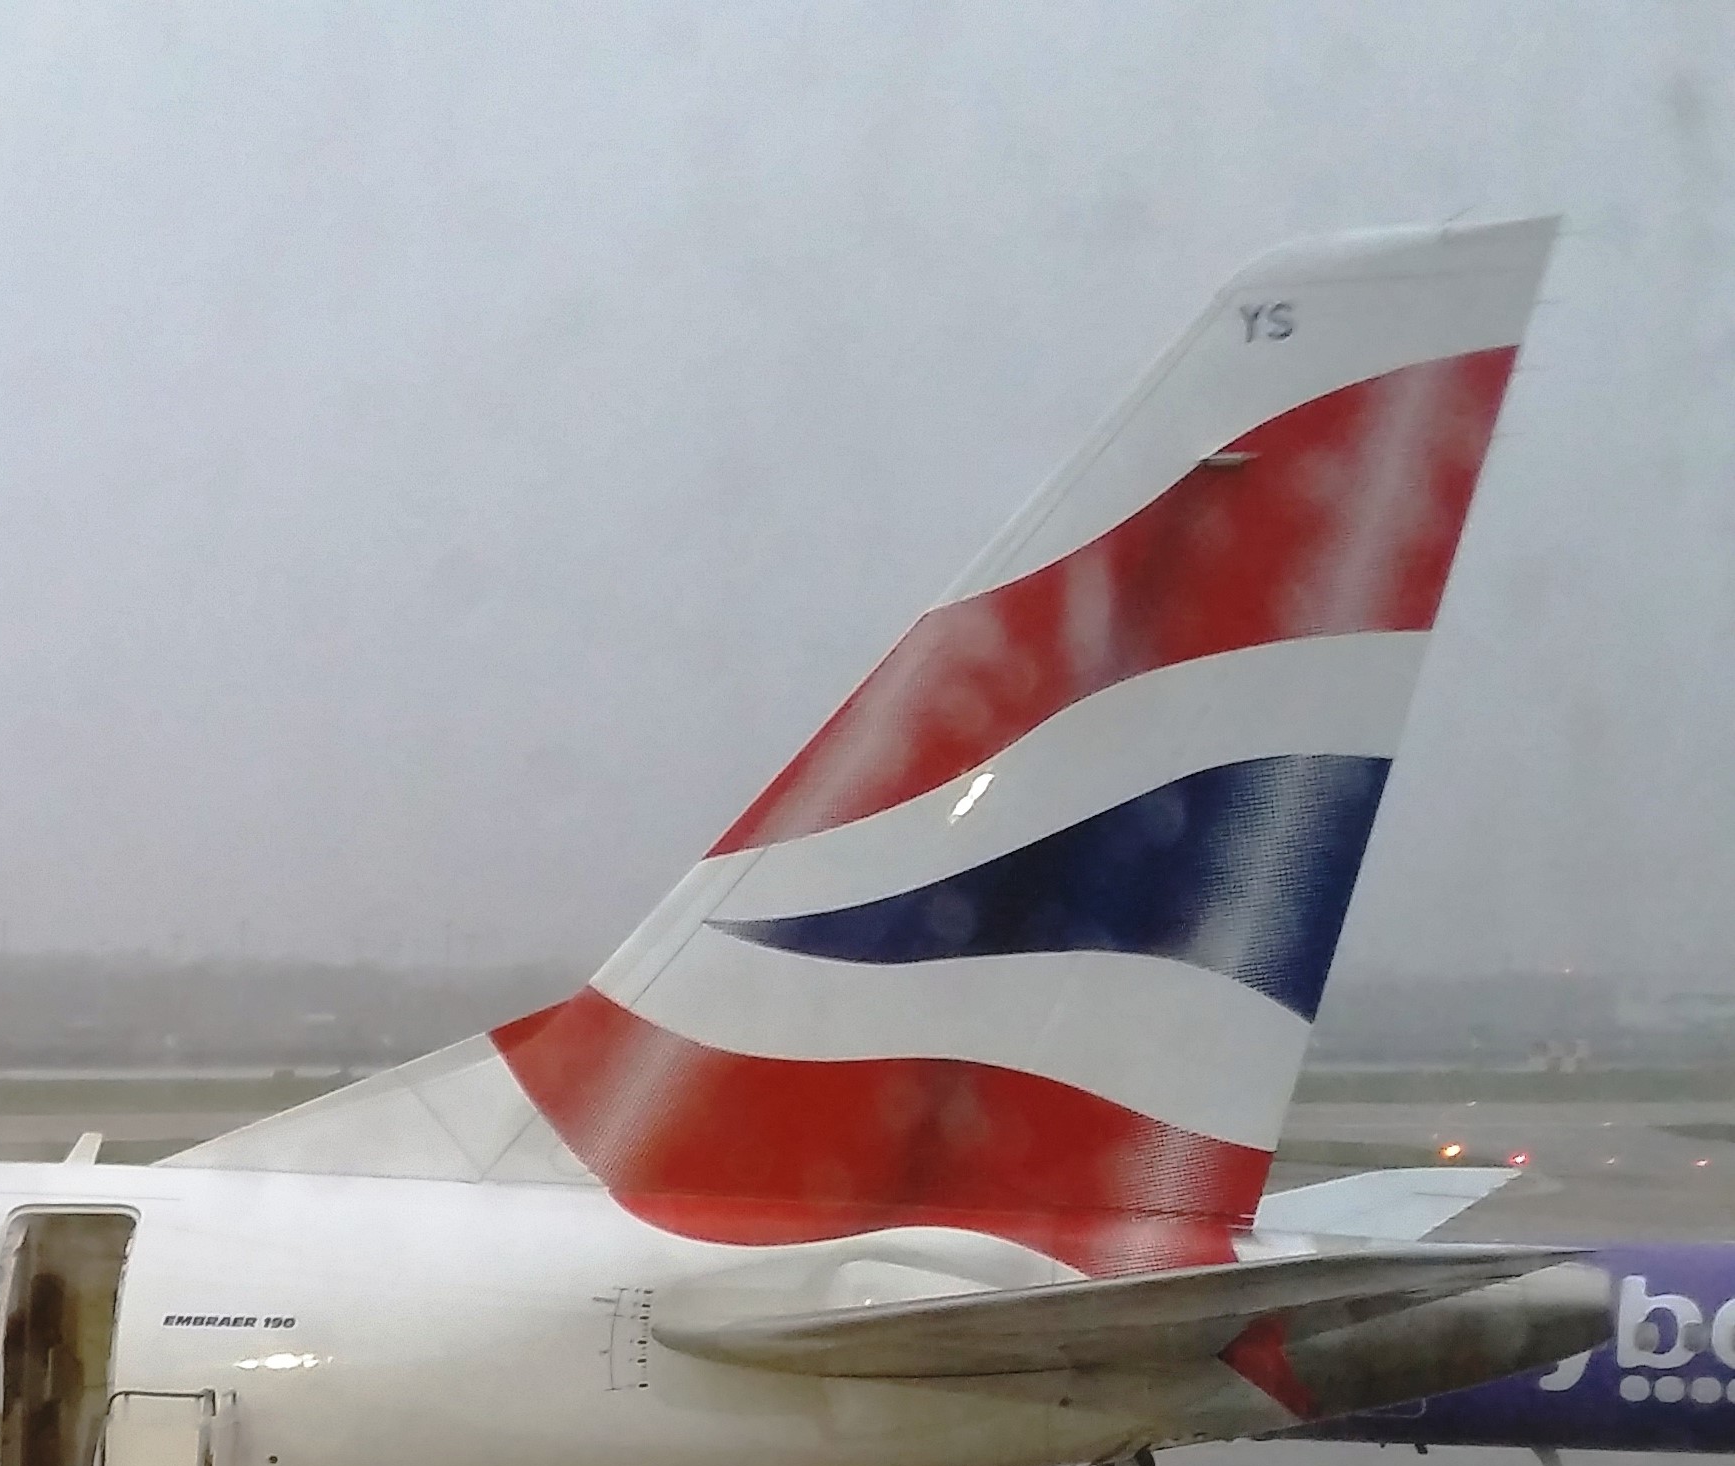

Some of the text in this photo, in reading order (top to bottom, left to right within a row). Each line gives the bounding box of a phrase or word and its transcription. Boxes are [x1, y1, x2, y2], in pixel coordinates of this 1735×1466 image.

[1239, 301, 1294, 343] YS
[162, 1315, 296, 1329] EMBRAER 190
